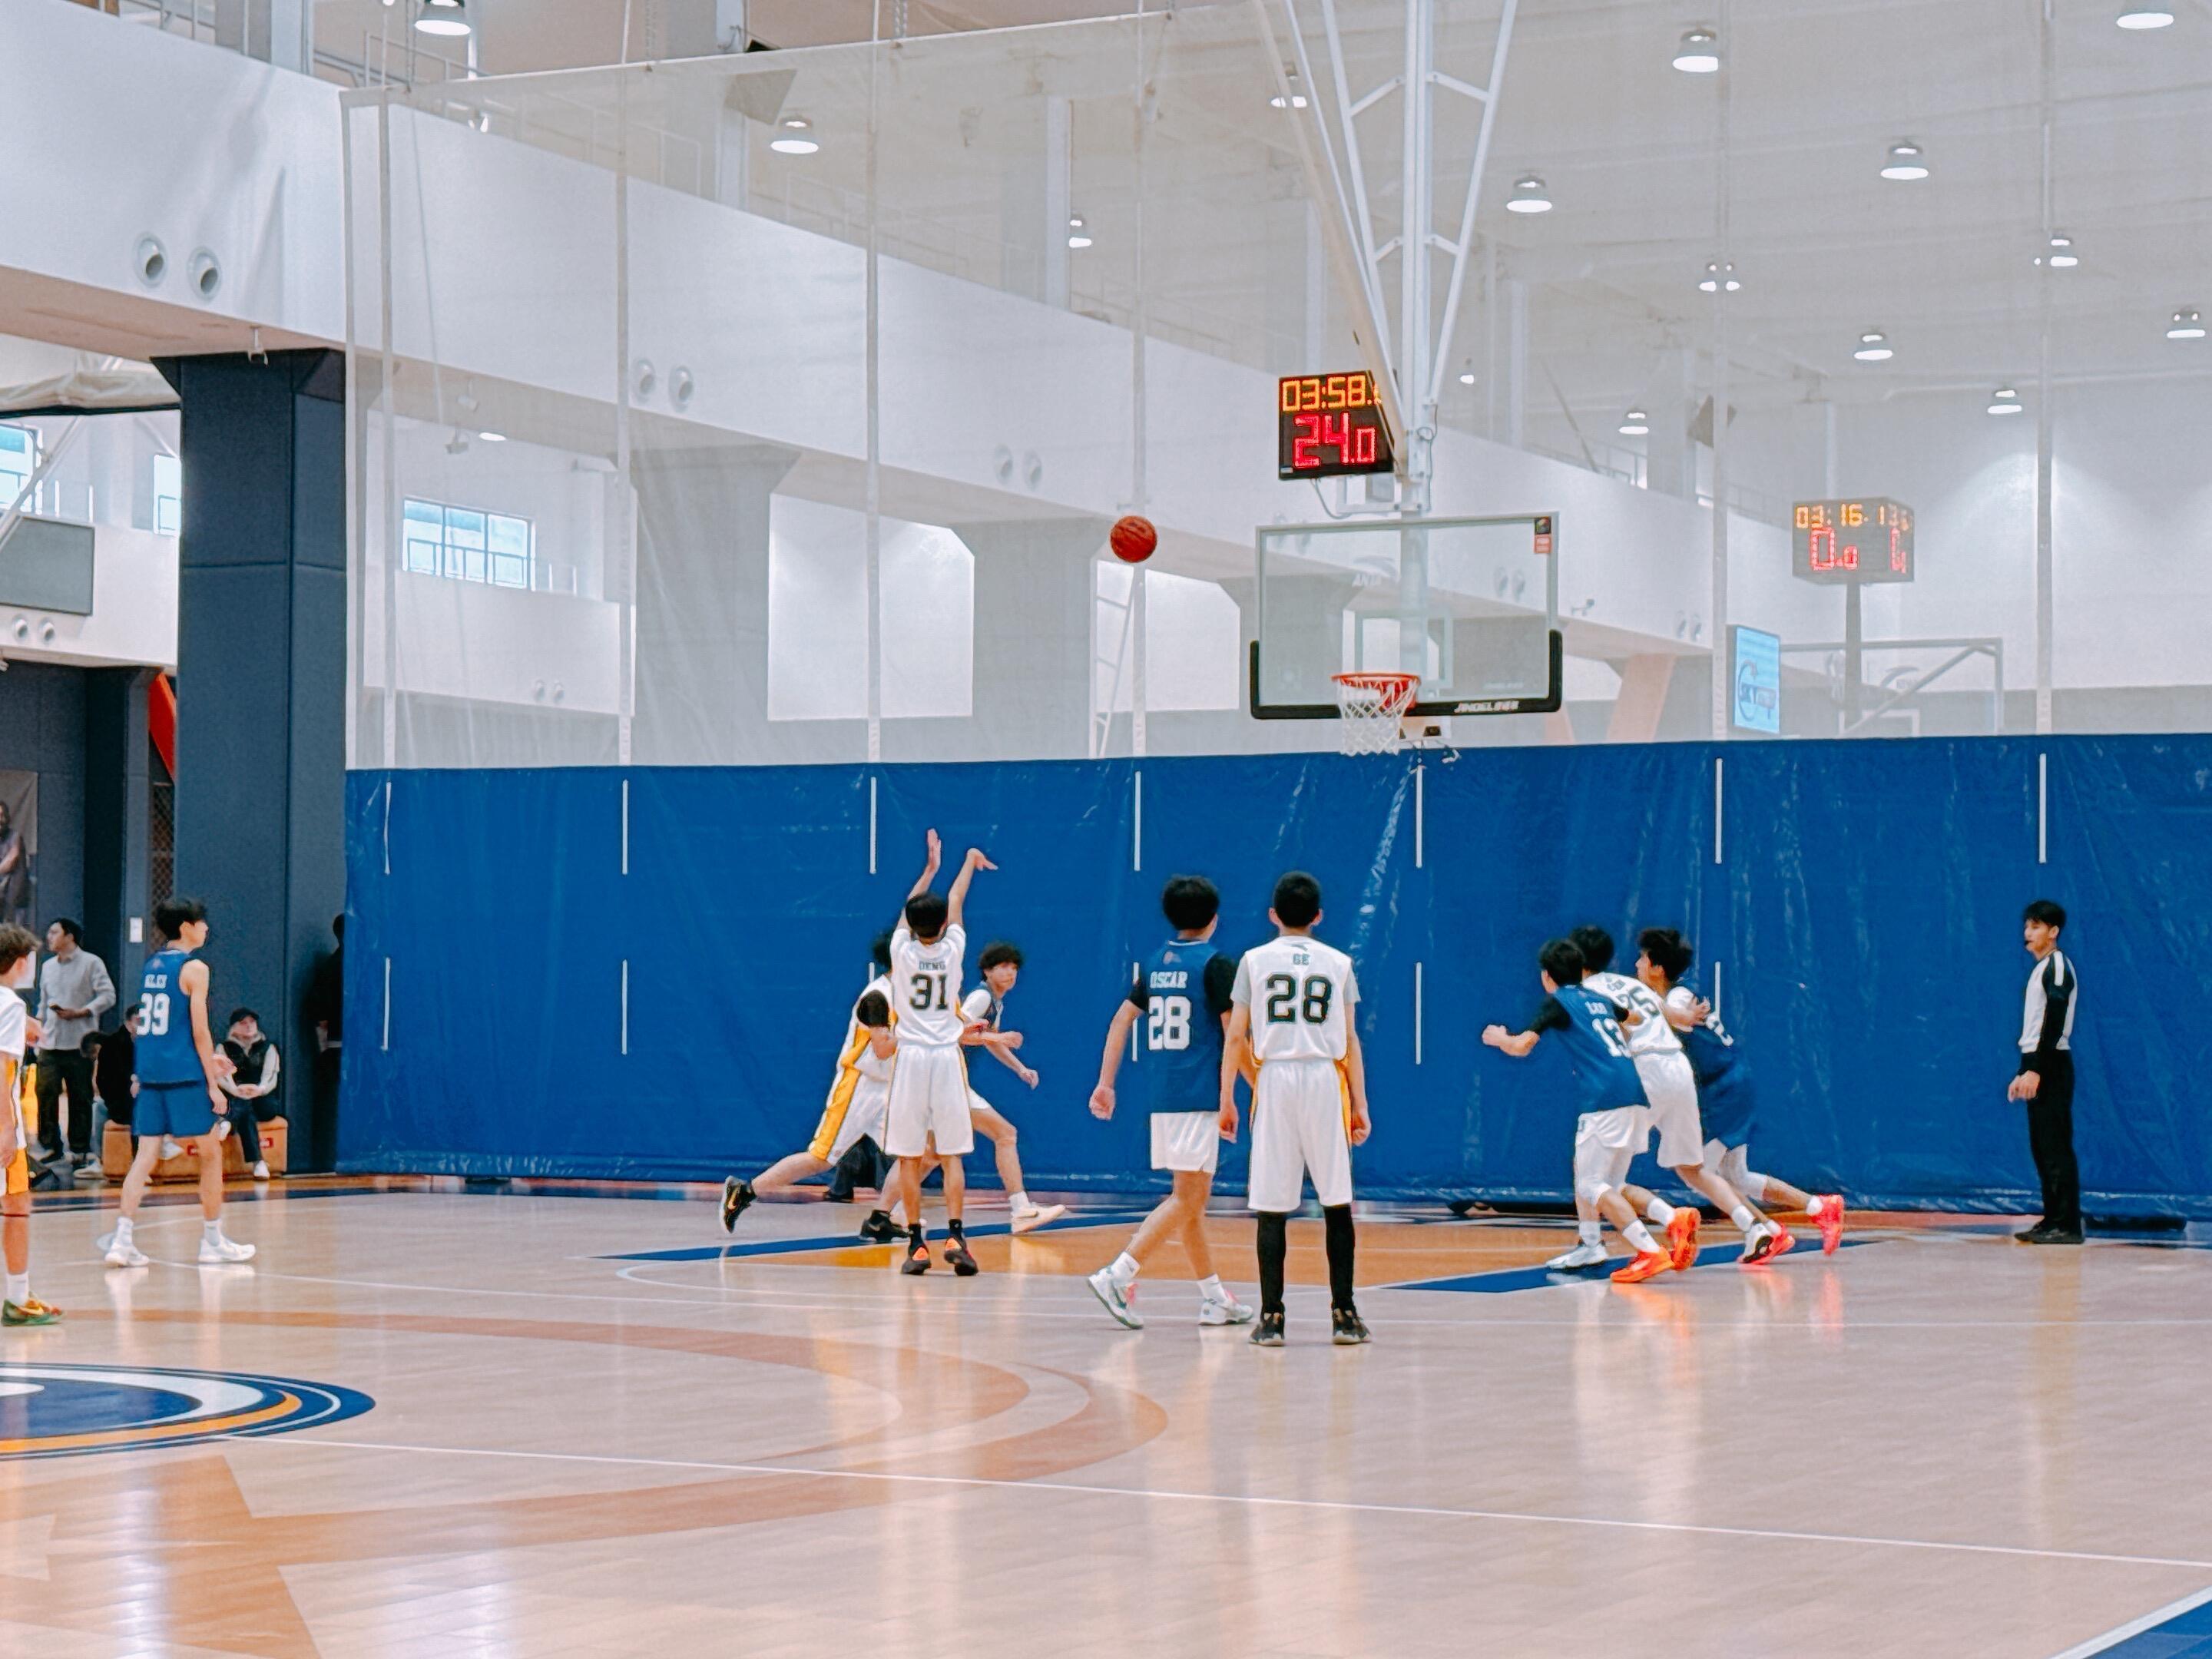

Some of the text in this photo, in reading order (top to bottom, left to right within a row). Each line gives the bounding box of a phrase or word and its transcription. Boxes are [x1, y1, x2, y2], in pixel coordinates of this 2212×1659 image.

[1294, 412, 1376, 468] 24.0
[909, 973, 949, 1010] 31
[1151, 971, 1188, 988] OSCAR
[1267, 972, 1333, 1024] 28
[137, 992, 170, 1035] 39
[1148, 995, 1191, 1051] 28
